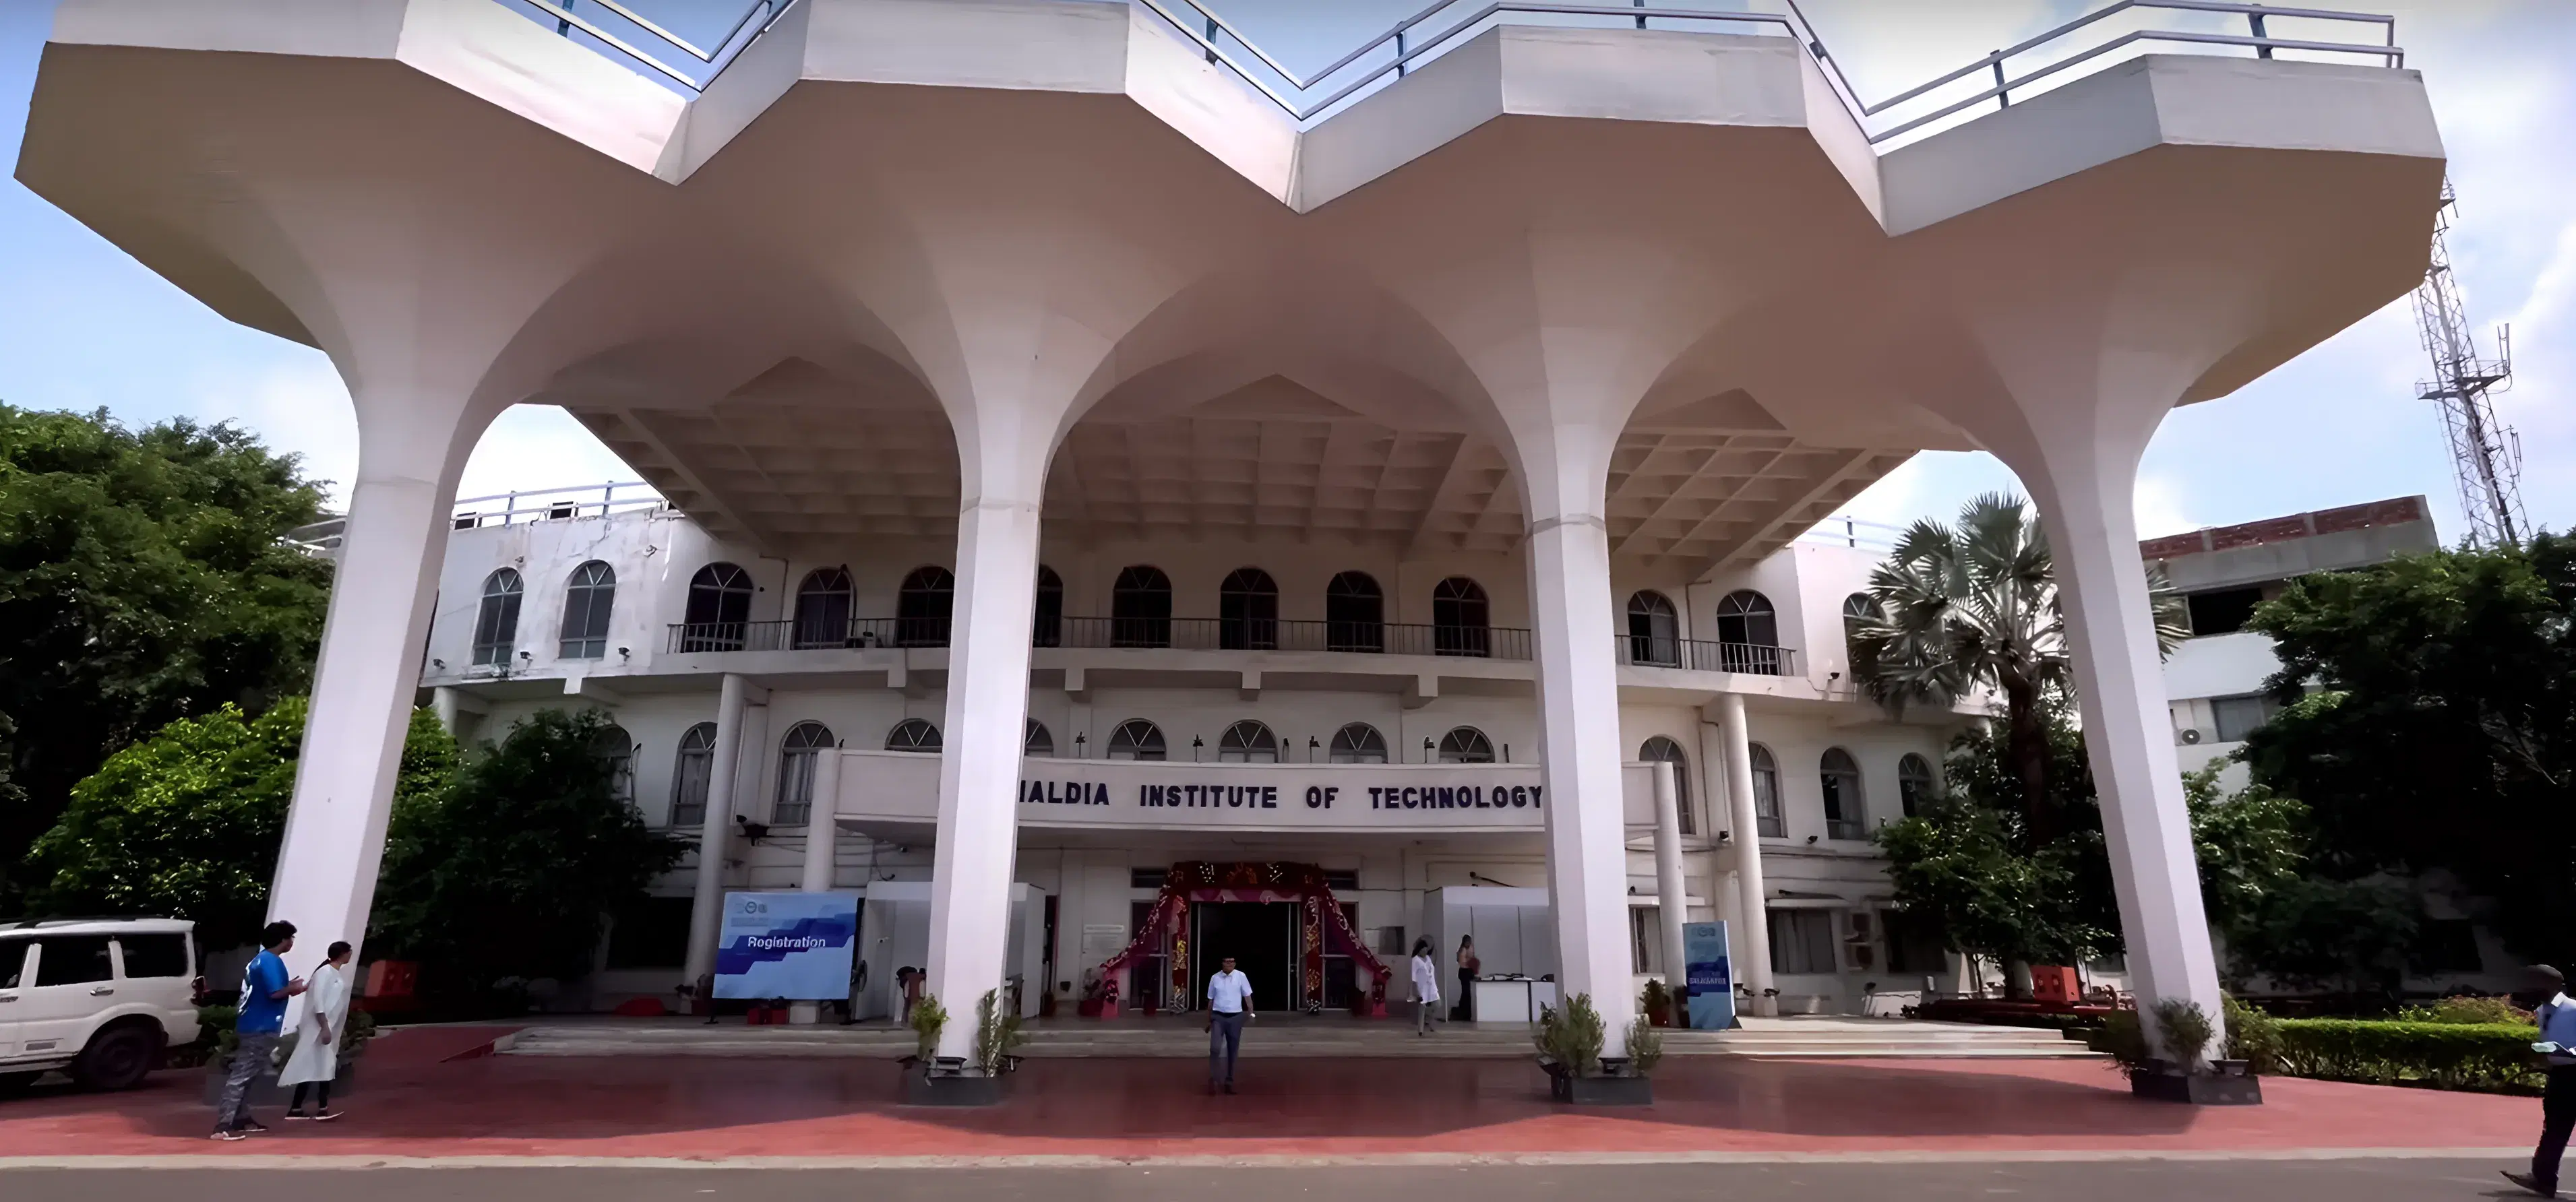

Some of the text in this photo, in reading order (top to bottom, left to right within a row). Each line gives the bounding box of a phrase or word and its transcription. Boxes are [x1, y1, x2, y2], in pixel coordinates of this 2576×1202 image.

[1140, 785, 1277, 809] INSTITUTE
[1306, 786, 1339, 809] OF
[1368, 786, 1542, 809] TECHNOLOGY
